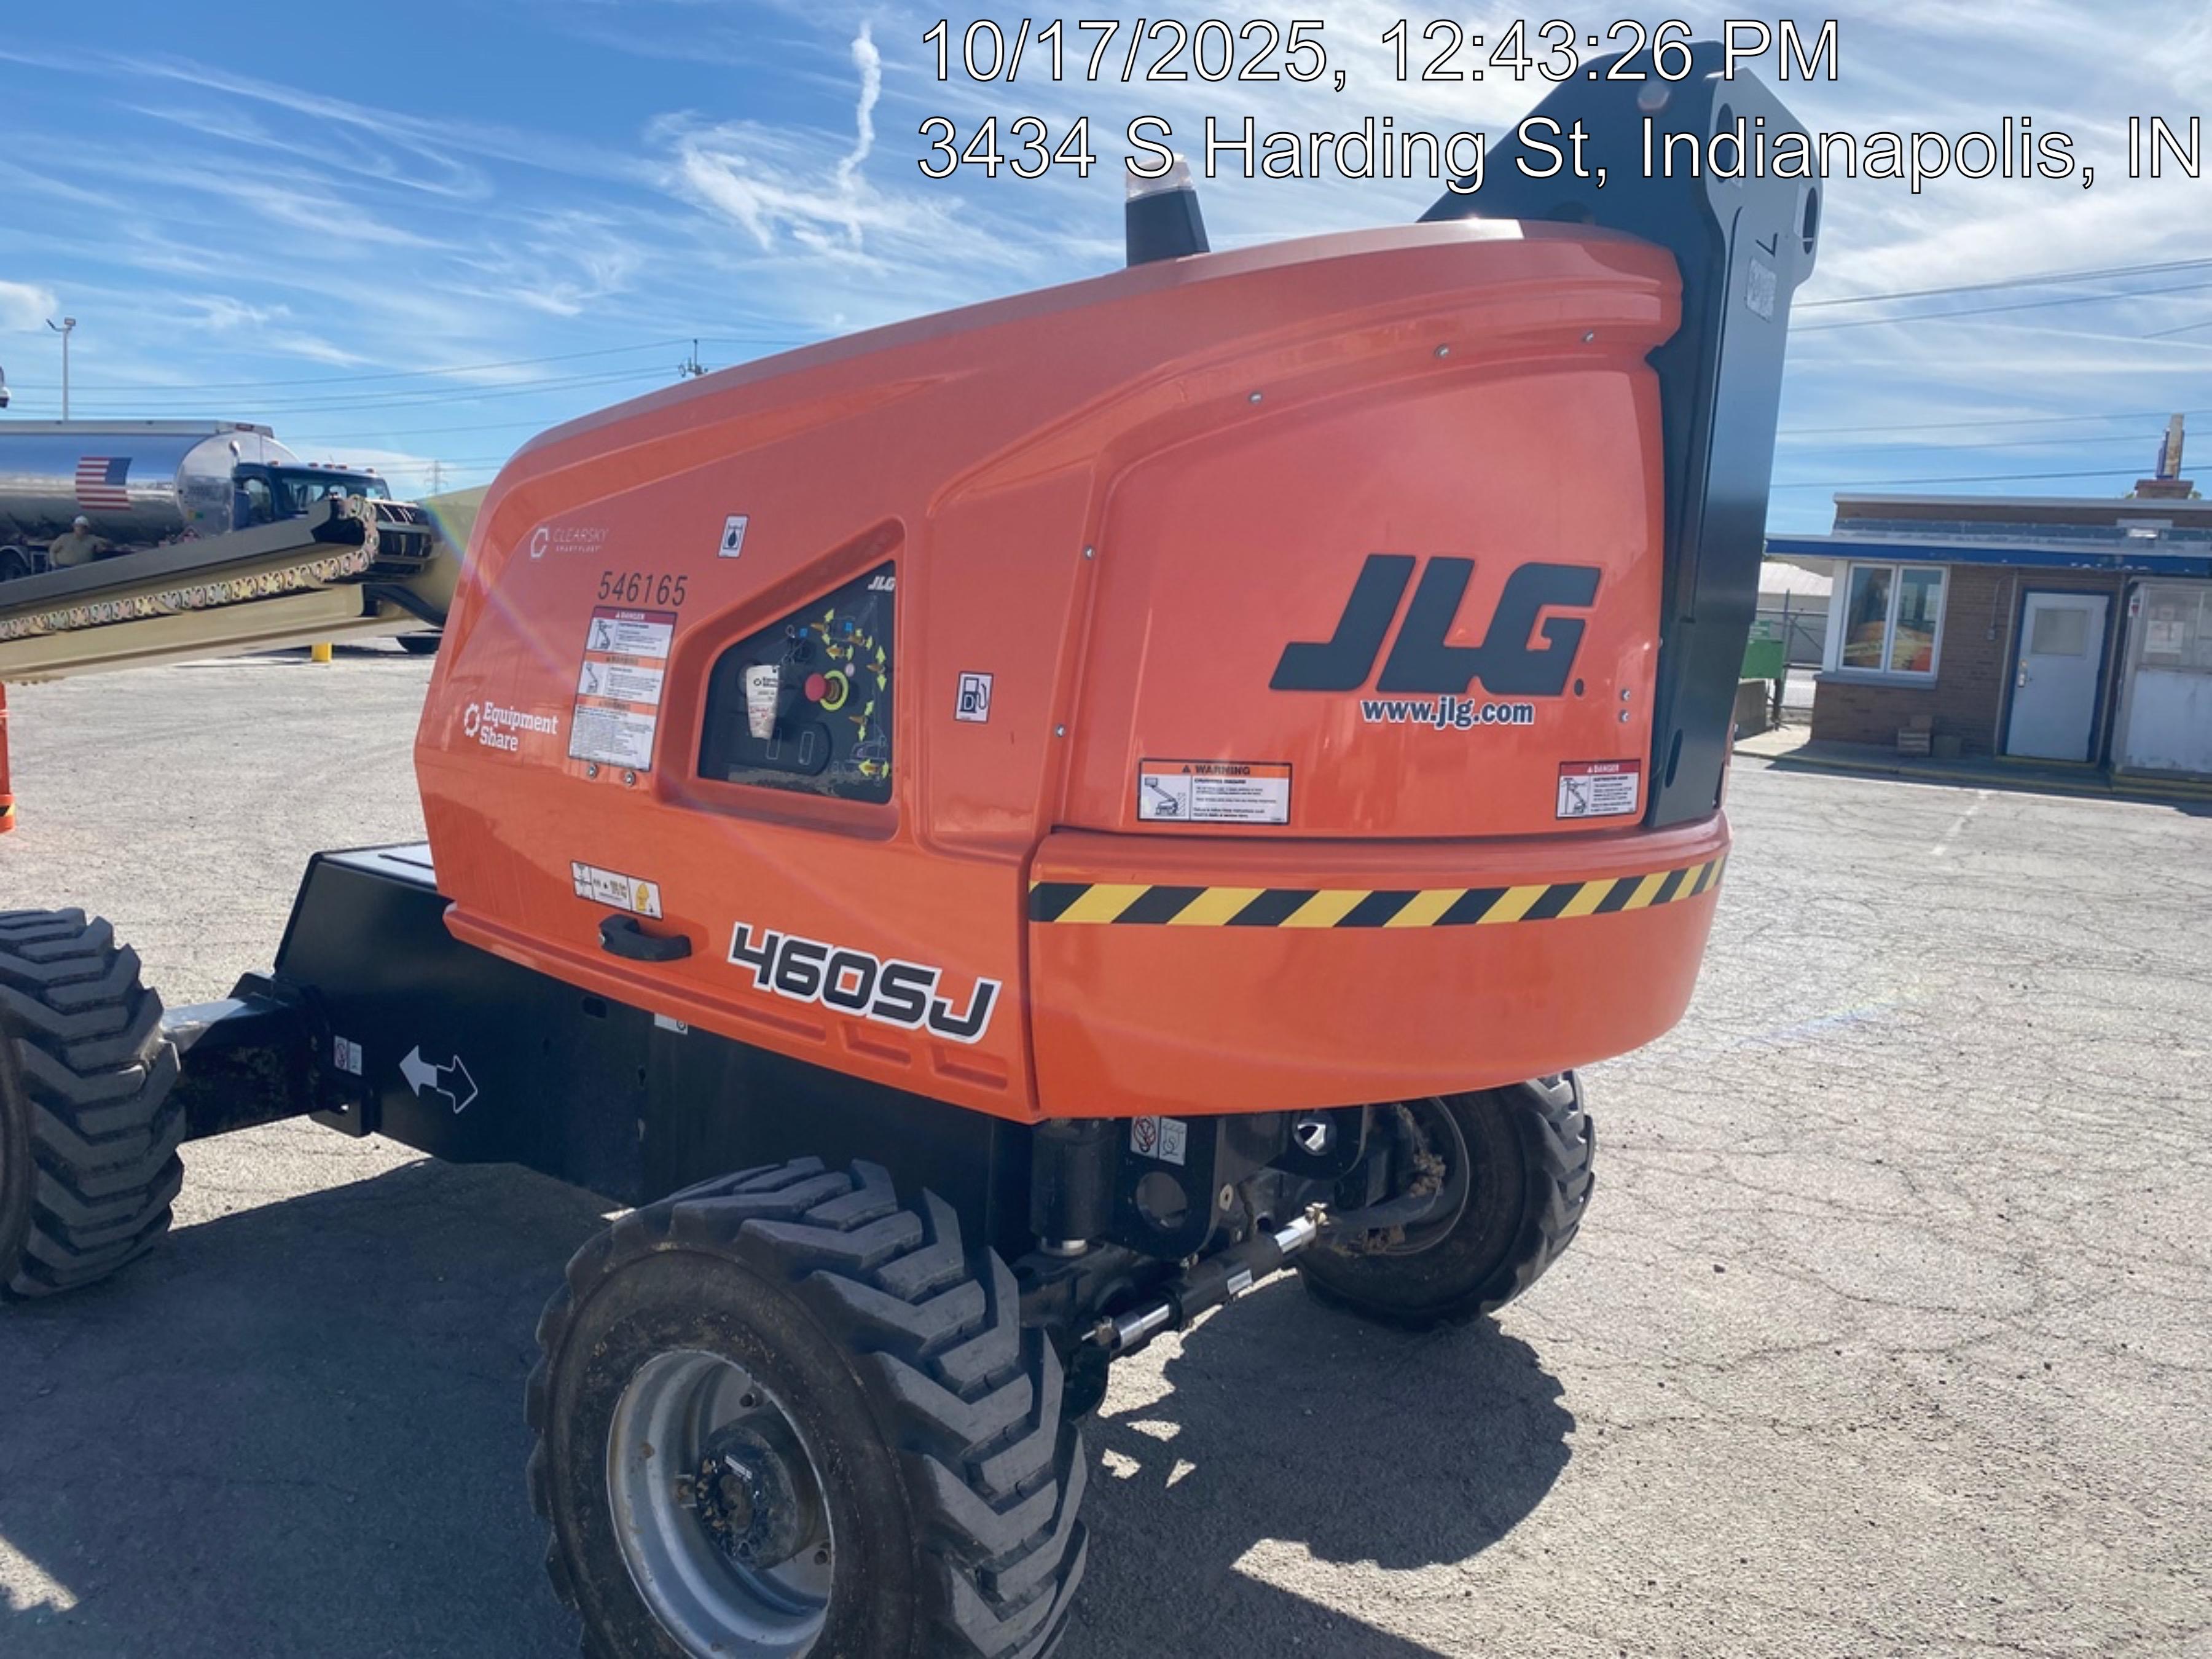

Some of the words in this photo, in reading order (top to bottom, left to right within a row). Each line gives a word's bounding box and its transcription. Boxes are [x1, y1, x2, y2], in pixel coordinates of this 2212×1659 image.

[598, 571, 688, 606] 546165
[868, 576, 896, 591] JLG
[1269, 554, 1601, 697] JLG
[482, 701, 559, 734] Equipment
[1360, 695, 1534, 730] www.jlg.com
[479, 726, 519, 751] Share
[1195, 765, 1250, 775] WARNING
[728, 921, 1002, 1044] 460SJ
